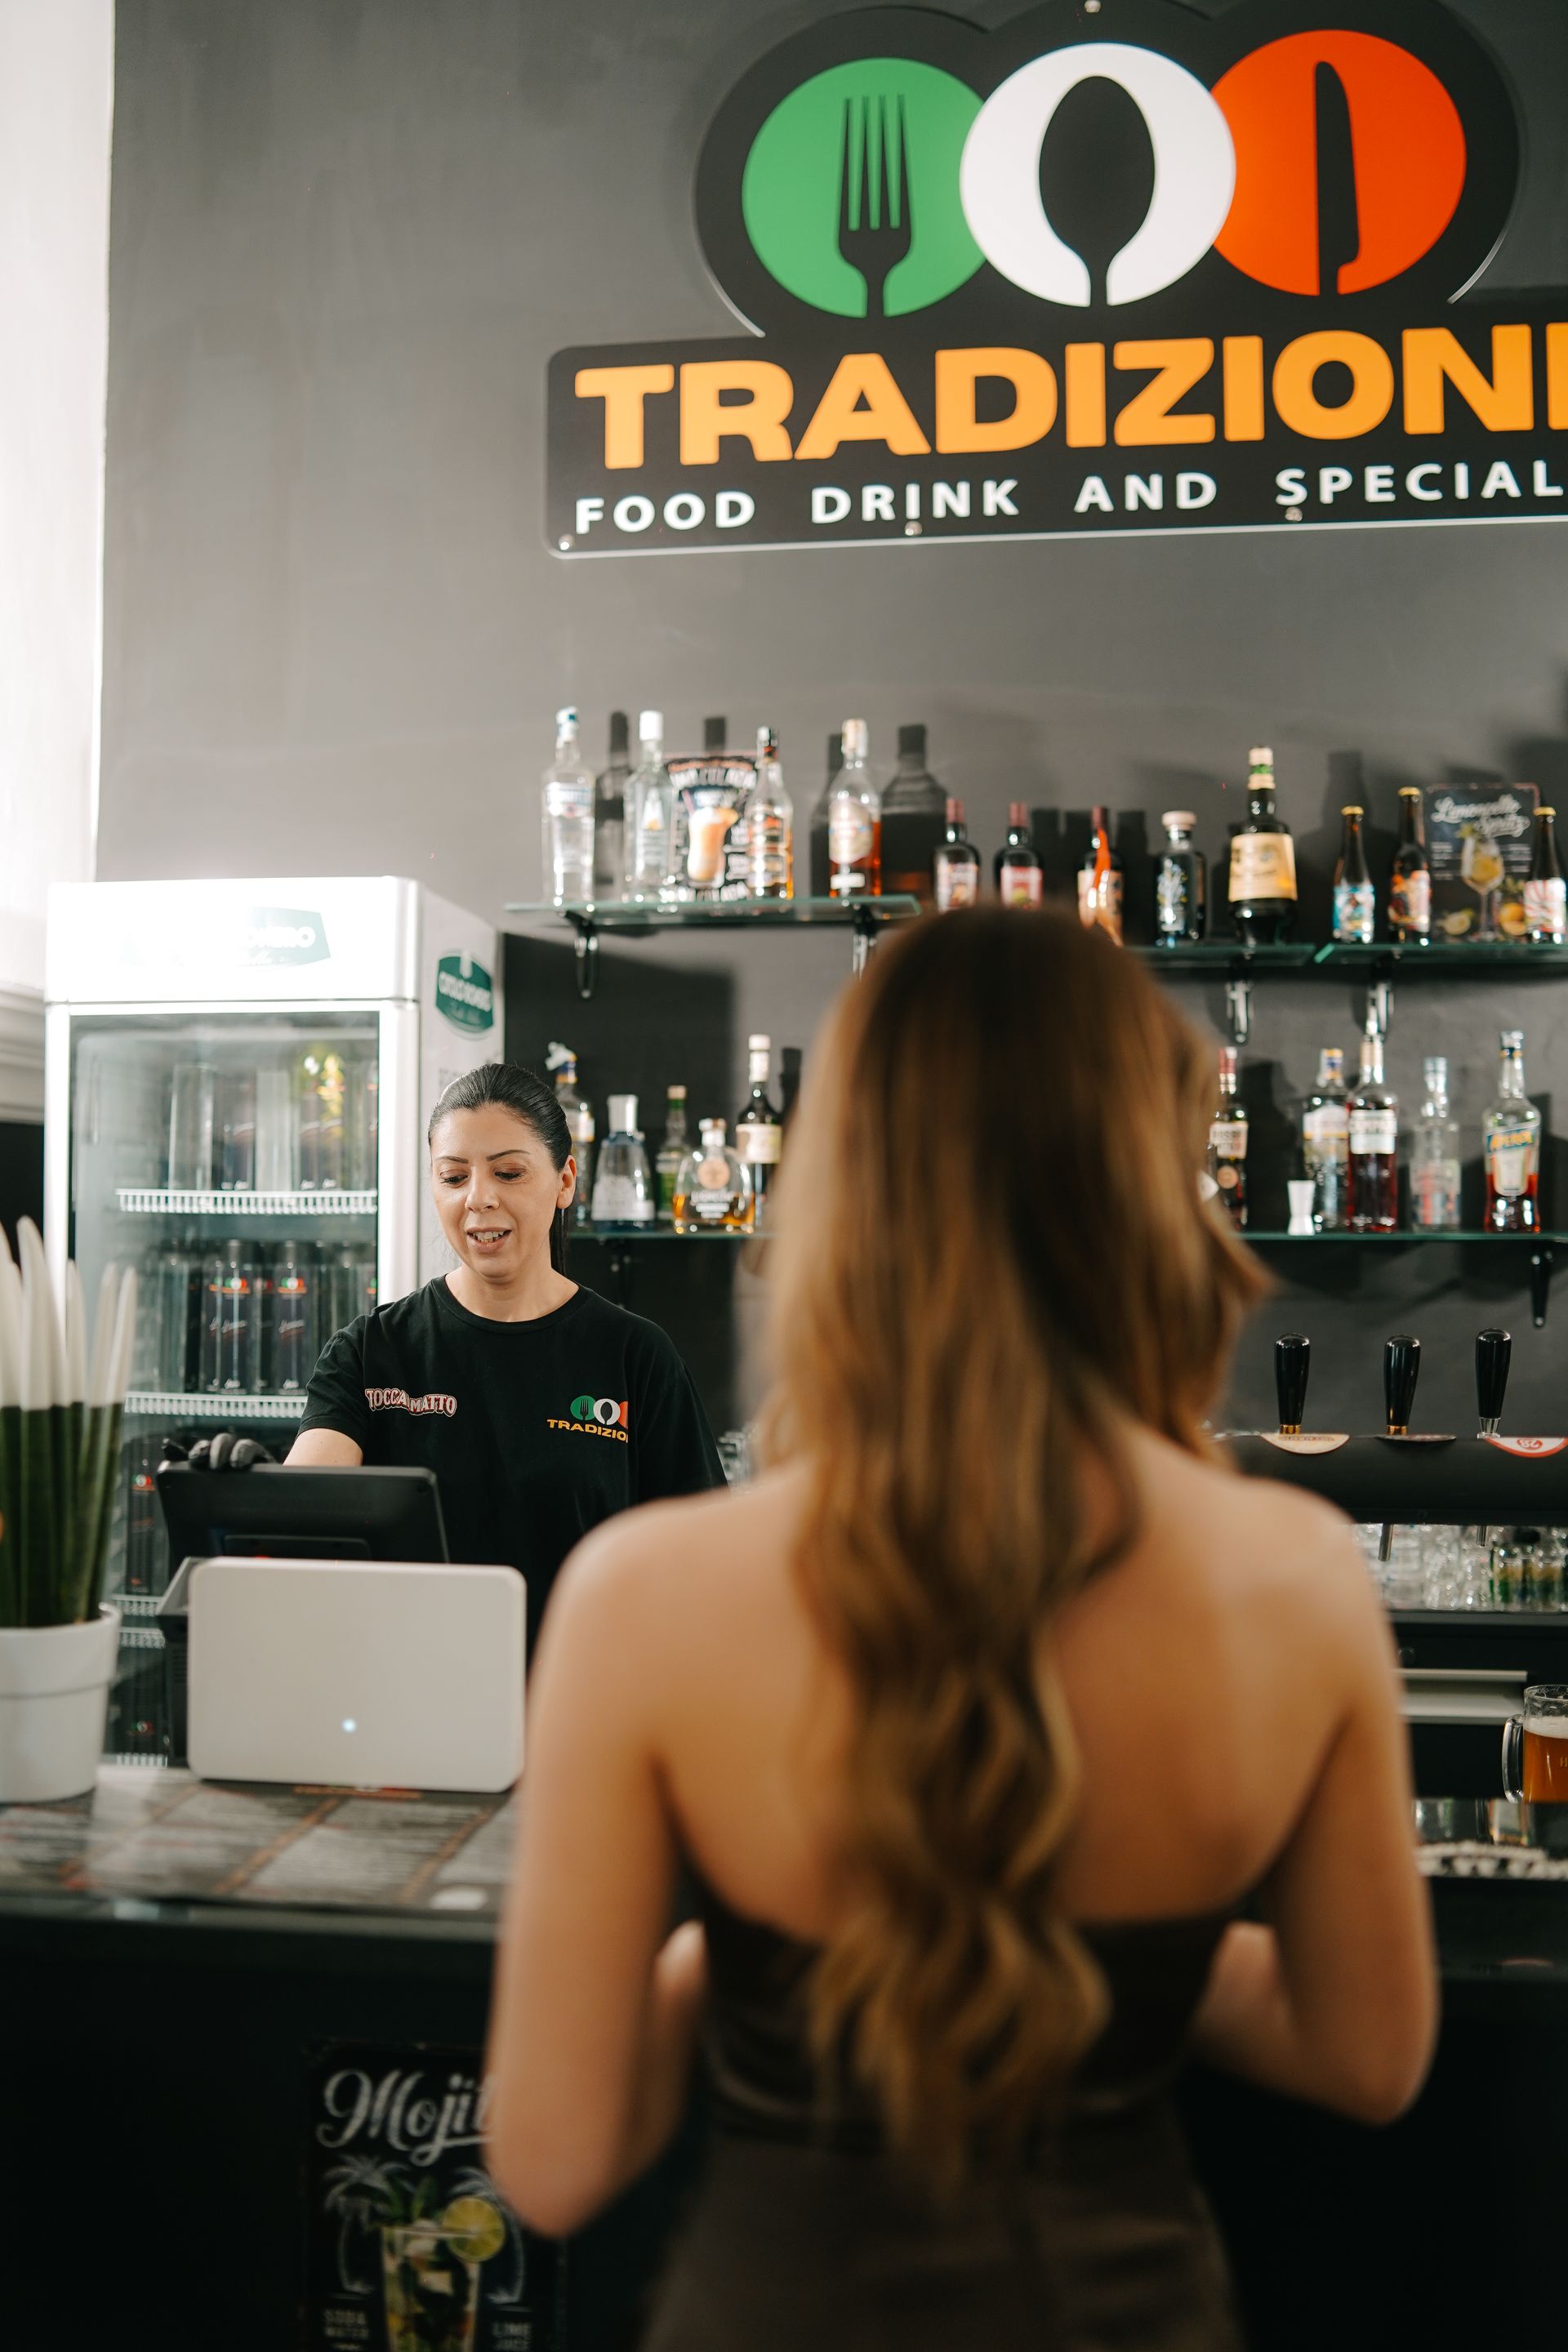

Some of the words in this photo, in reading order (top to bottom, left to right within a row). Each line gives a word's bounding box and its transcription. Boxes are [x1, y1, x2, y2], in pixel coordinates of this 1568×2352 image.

[575, 323, 1568, 470] TRADIZION
[576, 491, 755, 534] FOOD
[811, 479, 1019, 523] DRINK
[1074, 472, 1217, 512] AND
[546, 1419, 629, 1443] TRADIZIO
